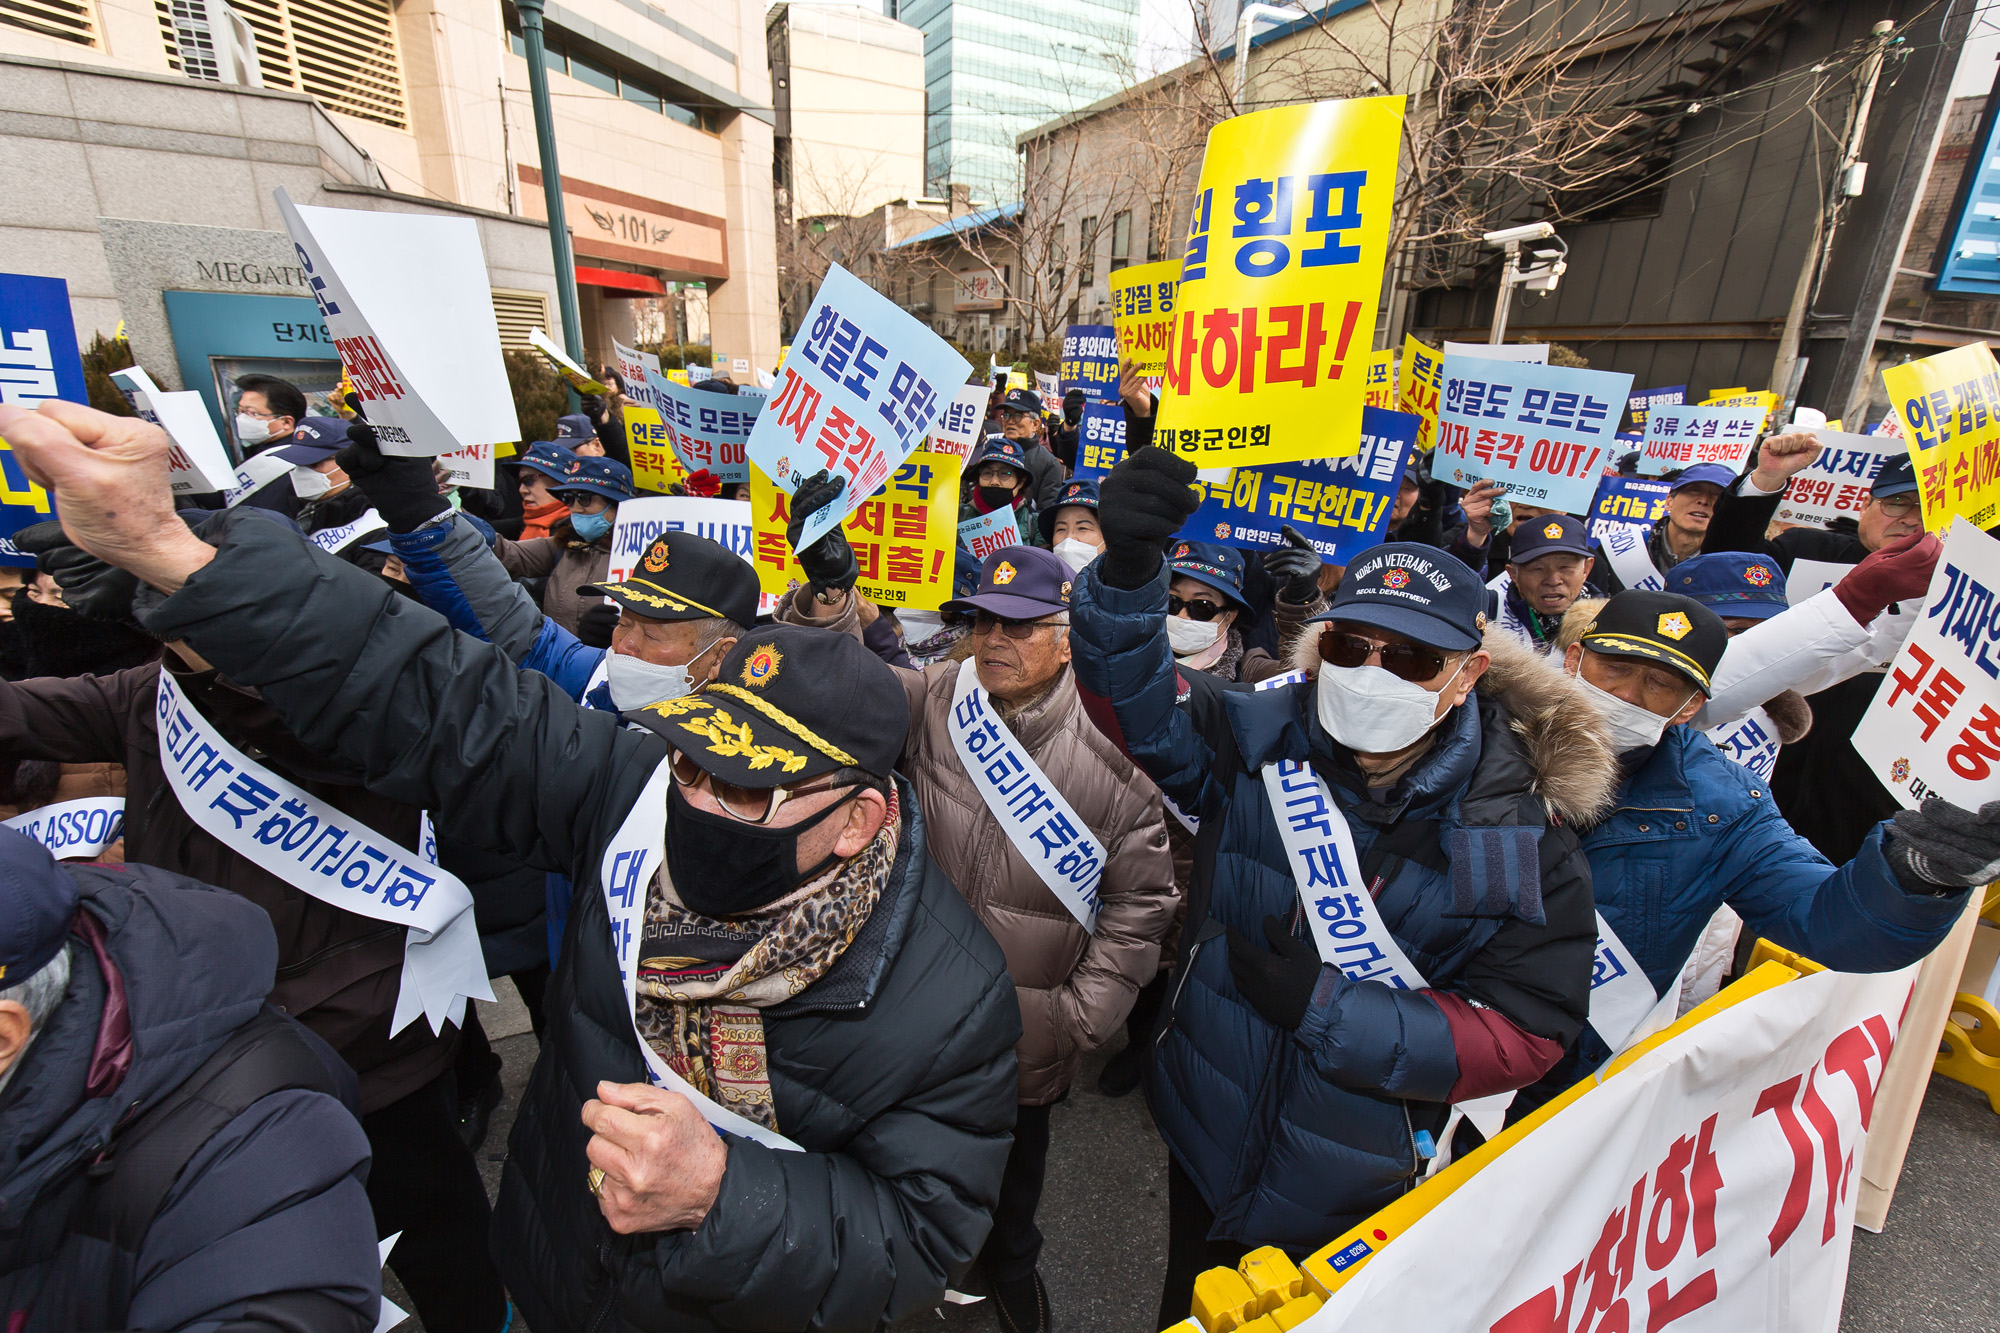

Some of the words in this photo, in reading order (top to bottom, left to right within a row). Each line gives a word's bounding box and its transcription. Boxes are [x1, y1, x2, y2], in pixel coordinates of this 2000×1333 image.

[618, 213, 647, 243] 101
[1232, 170, 1368, 277] 횡포
[1125, 284, 1151, 316] 갑질
[1158, 281, 1179, 312] 횡
[802, 304, 889, 402] 한글도
[1083, 362, 1118, 382] 먹냐?
[651, 384, 692, 429] 한글도
[1446, 378, 1513, 419] 한글도
[1517, 388, 1609, 434] 모르는
[1905, 390, 1951, 451] 언론
[1952, 378, 1988, 436] 갑질
[631, 422, 666, 447] 언론
[770, 367, 823, 445] 기자
[815, 405, 876, 489] 즉각
[1086, 416, 1127, 444] 향군은
[1653, 417, 1680, 436] 3류
[1684, 418, 1719, 438] 소설
[1723, 419, 1755, 438] 쓰는
[633, 450, 665, 476] 즉각
[680, 432, 713, 465] 즉각
[1083, 445, 1117, 469] 밥도
[1301, 434, 1403, 482] 저널
[1438, 420, 1470, 459] 기자
[1474, 428, 1525, 470] 즉각
[1529, 438, 1602, 479] OUT!
[1644, 440, 1694, 462] 시사저널
[1696, 443, 1751, 462] 각성하라!
[1269, 474, 1390, 533] 규탄한다!
[1921, 458, 1948, 517] 즉각
[1599, 495, 1647, 519] 먹냐?
[971, 525, 1017, 560] 시사저널
[1234, 527, 1337, 556] 대한민국재인회
[1354, 556, 1383, 582] KOREAN
[1384, 553, 1433, 575] VETERANS
[1426, 569, 1452, 592] ASSN
[1356, 588, 1377, 596] SEOUL
[1378, 588, 1431, 606] DEPARTMENT
[1886, 642, 1966, 743] 구독
